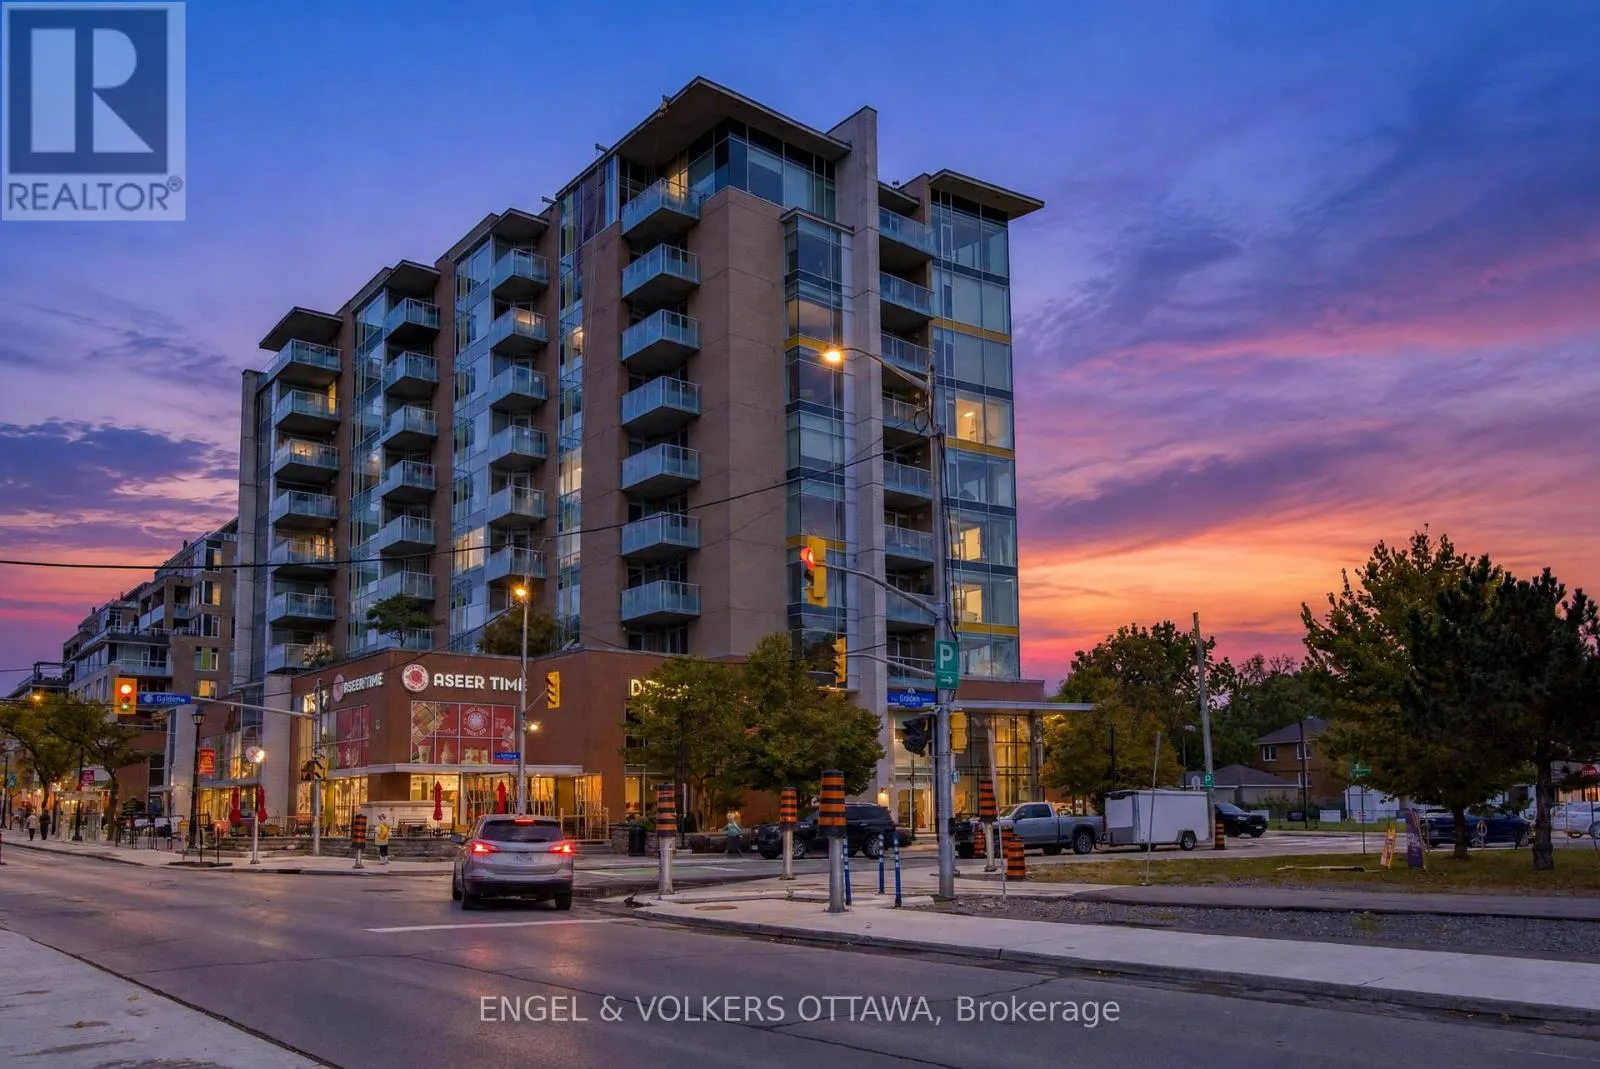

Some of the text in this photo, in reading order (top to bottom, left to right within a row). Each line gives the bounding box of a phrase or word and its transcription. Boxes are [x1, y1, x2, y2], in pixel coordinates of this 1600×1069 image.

[939, 644, 954, 669] P
[343, 677, 366, 693] ASEER
[364, 671, 385, 689] TIME
[433, 673, 486, 690] ASEER
[489, 676, 528, 692] TIM
[156, 695, 181, 703] Golden
[899, 694, 921, 703] Golden
